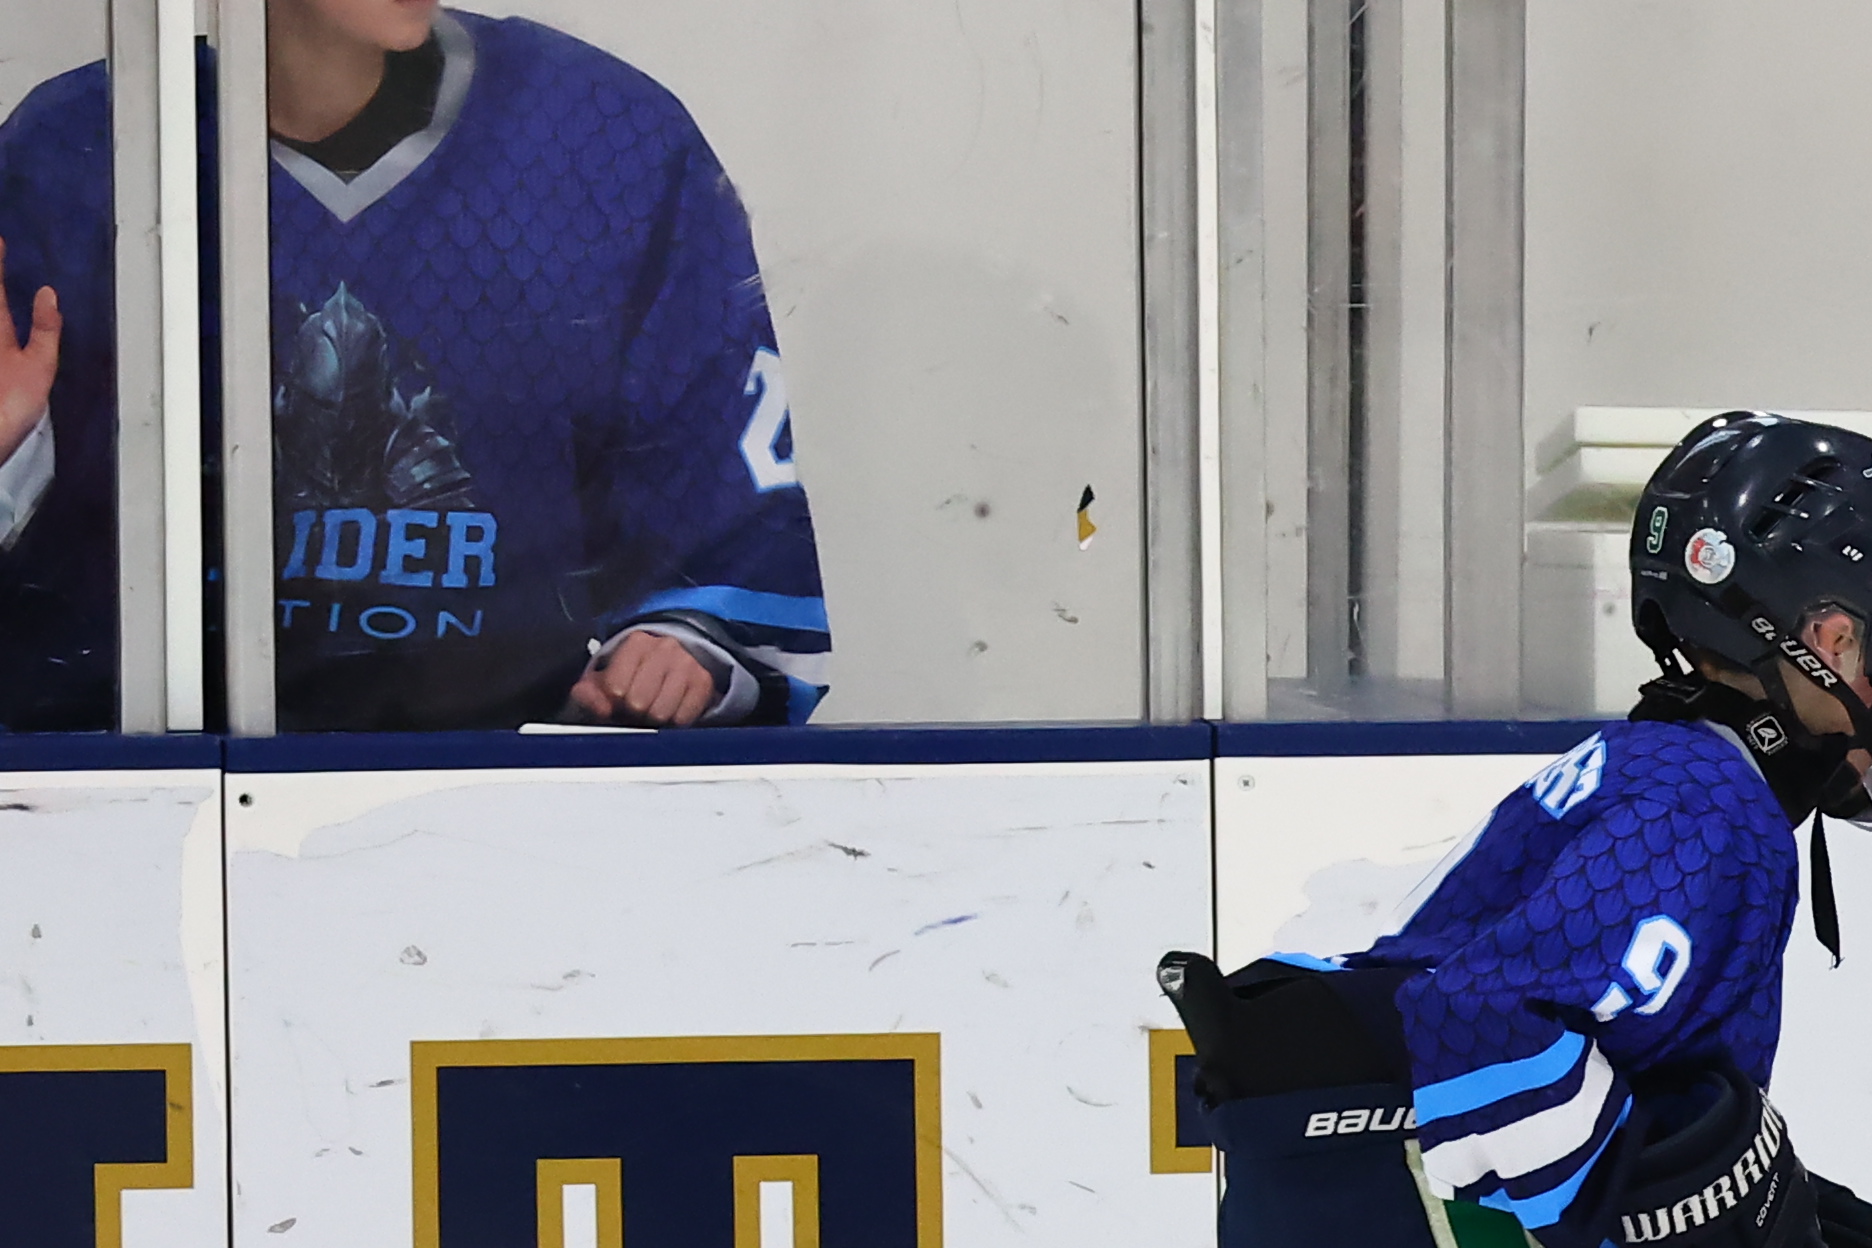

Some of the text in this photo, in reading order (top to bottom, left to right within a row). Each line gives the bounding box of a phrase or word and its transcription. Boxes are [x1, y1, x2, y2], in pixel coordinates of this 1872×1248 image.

[281, 507, 498, 588] IDER
[1645, 505, 1669, 554] 9
[277, 599, 484, 639] TION
[1755, 1172, 1780, 1228] COVERT
